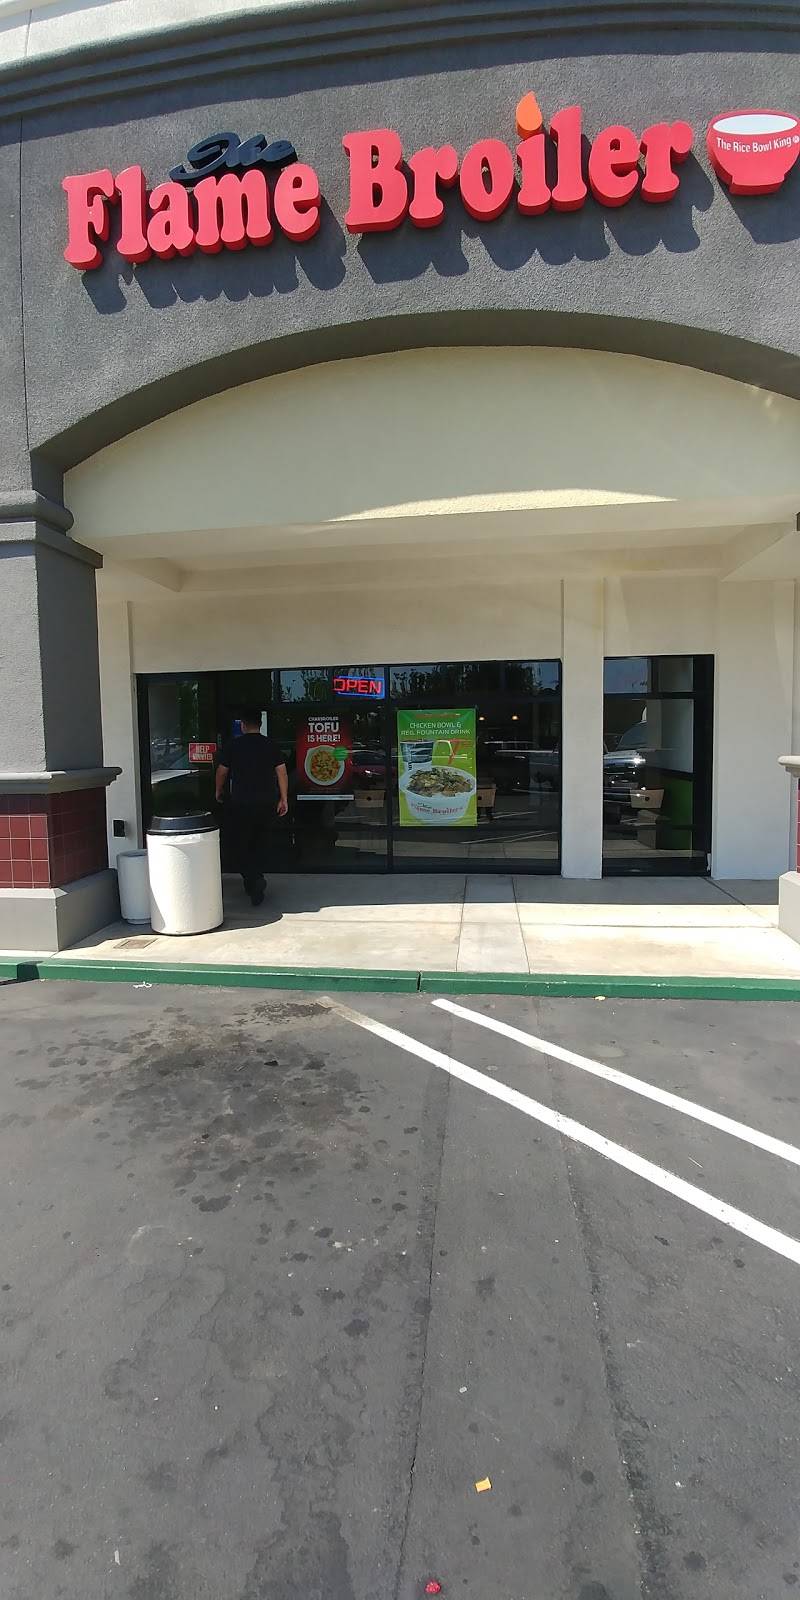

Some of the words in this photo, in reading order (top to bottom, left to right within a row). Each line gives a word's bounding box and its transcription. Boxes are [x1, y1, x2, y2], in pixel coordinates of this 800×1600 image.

[716, 137, 731, 150] The
[733, 141, 750, 153] Rice
[752, 142, 772, 153] Bowl
[774, 136, 792, 149] King
[169, 131, 298, 184] The
[62, 164, 321, 271] Flame
[342, 90, 694, 234] Broiler
[333, 678, 382, 694] OPEN
[307, 722, 340, 733] TOFU
[437, 721, 456, 729] BOWL
[307, 734, 315, 743] IS
[316, 734, 341, 742] HERE!
[195, 744, 210, 754] HELP
